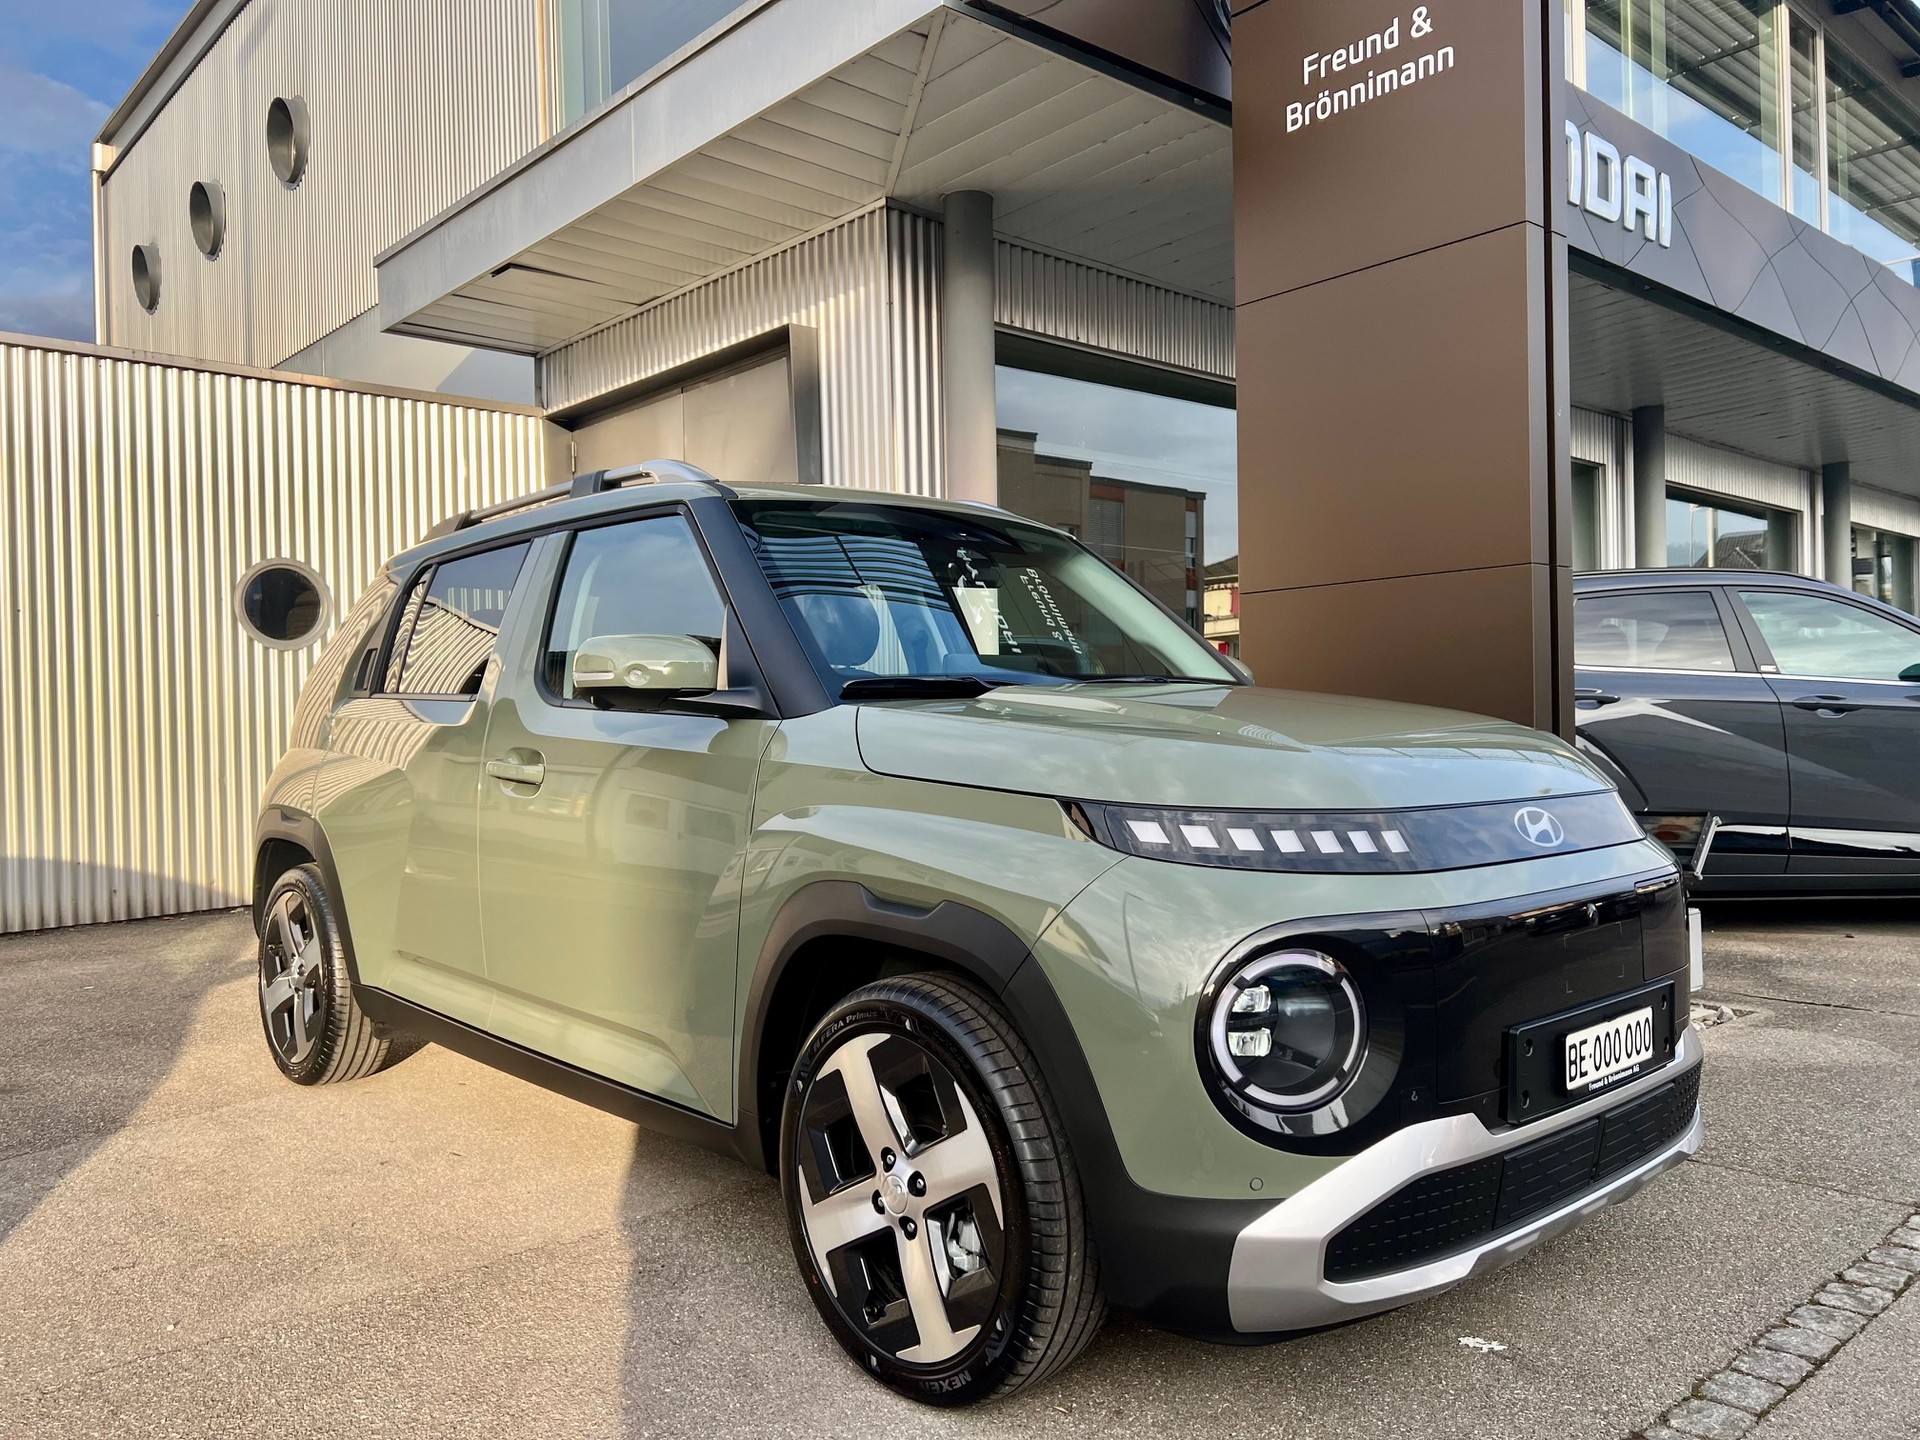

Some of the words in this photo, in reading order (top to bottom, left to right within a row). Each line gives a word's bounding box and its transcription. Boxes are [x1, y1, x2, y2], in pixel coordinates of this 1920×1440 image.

[1302, 16, 1400, 86] Freund
[1410, 5, 1434, 39] &
[1285, 45, 1455, 133] Brönnimann
[1625, 1016, 1652, 1060] 000
[1633, 1064, 1640, 1073] AG
